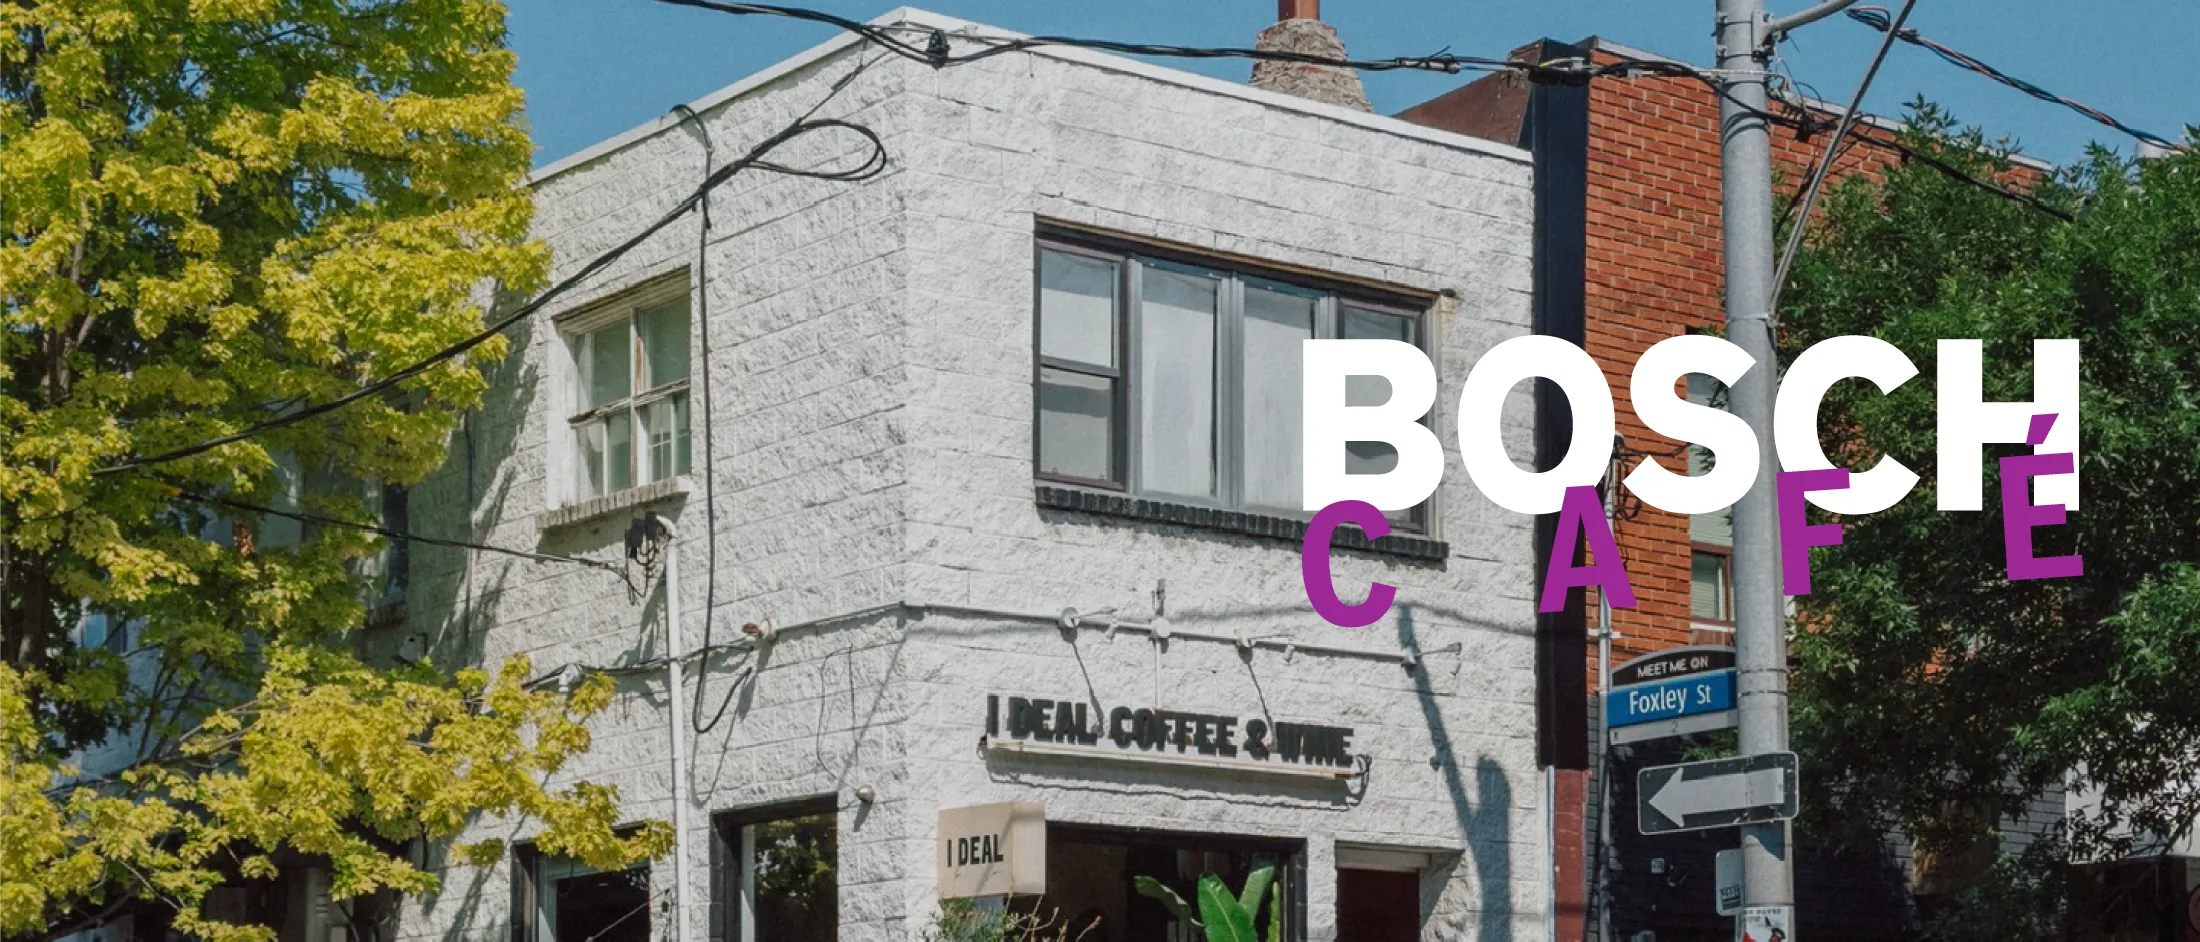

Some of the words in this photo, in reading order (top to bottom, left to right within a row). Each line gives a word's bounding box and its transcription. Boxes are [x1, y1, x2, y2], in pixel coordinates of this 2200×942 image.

[1637, 662, 1667, 678] MEET
[1670, 658, 1688, 672] ME
[1690, 655, 1709, 670] ON
[1629, 686, 1687, 715] Foxley
[1696, 684, 1712, 705] St
[986, 695, 999, 737] I
[1007, 696, 1098, 745] DEAL
[1109, 706, 1239, 757] COFFEE
[1244, 718, 1270, 761] &
[1273, 721, 1355, 767] WINE
[947, 838, 952, 868] I
[958, 833, 1004, 867] DEAL
